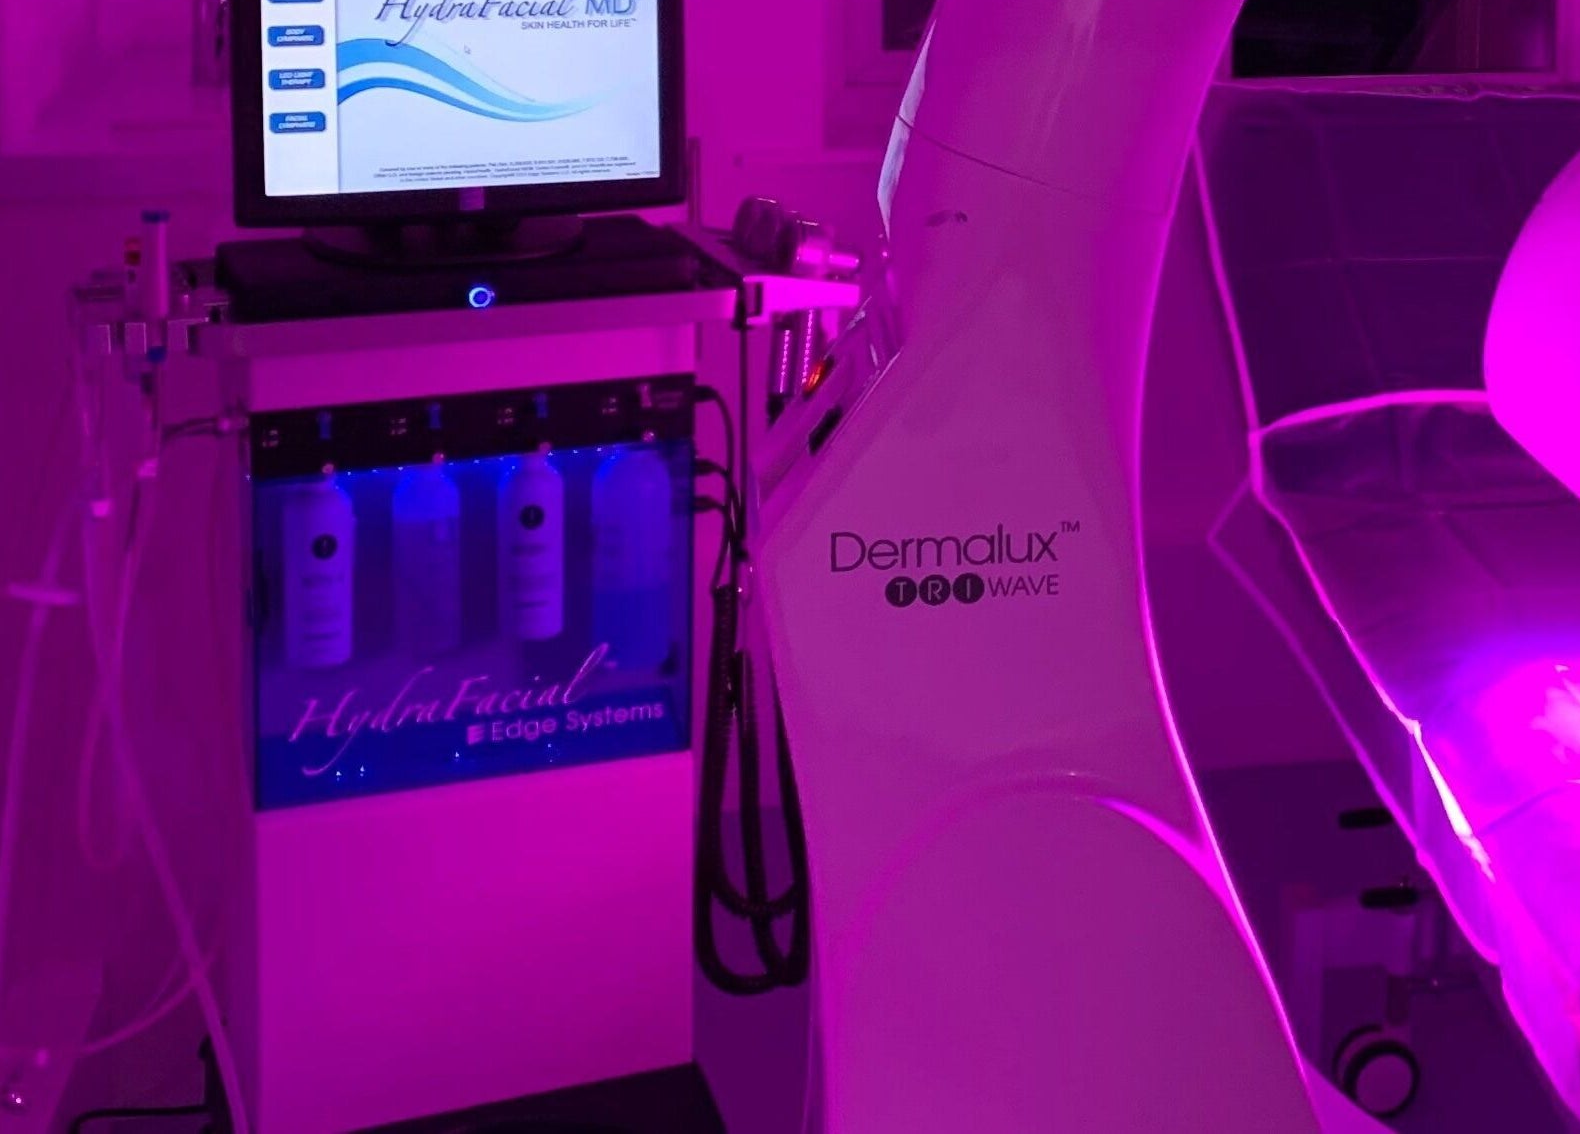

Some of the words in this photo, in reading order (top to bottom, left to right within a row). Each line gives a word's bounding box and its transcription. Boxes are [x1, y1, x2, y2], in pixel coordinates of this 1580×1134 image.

[521, 20, 545, 31] SKIN
[546, 19, 585, 30] HEALTH
[587, 18, 608, 29] FOR
[830, 523, 1059, 572] Dermalux
[890, 575, 979, 605] TRI
[987, 573, 1060, 598] WAVE
[289, 642, 609, 776] HydraFacial
[491, 715, 558, 742] Edge
[566, 702, 664, 732] Systems
